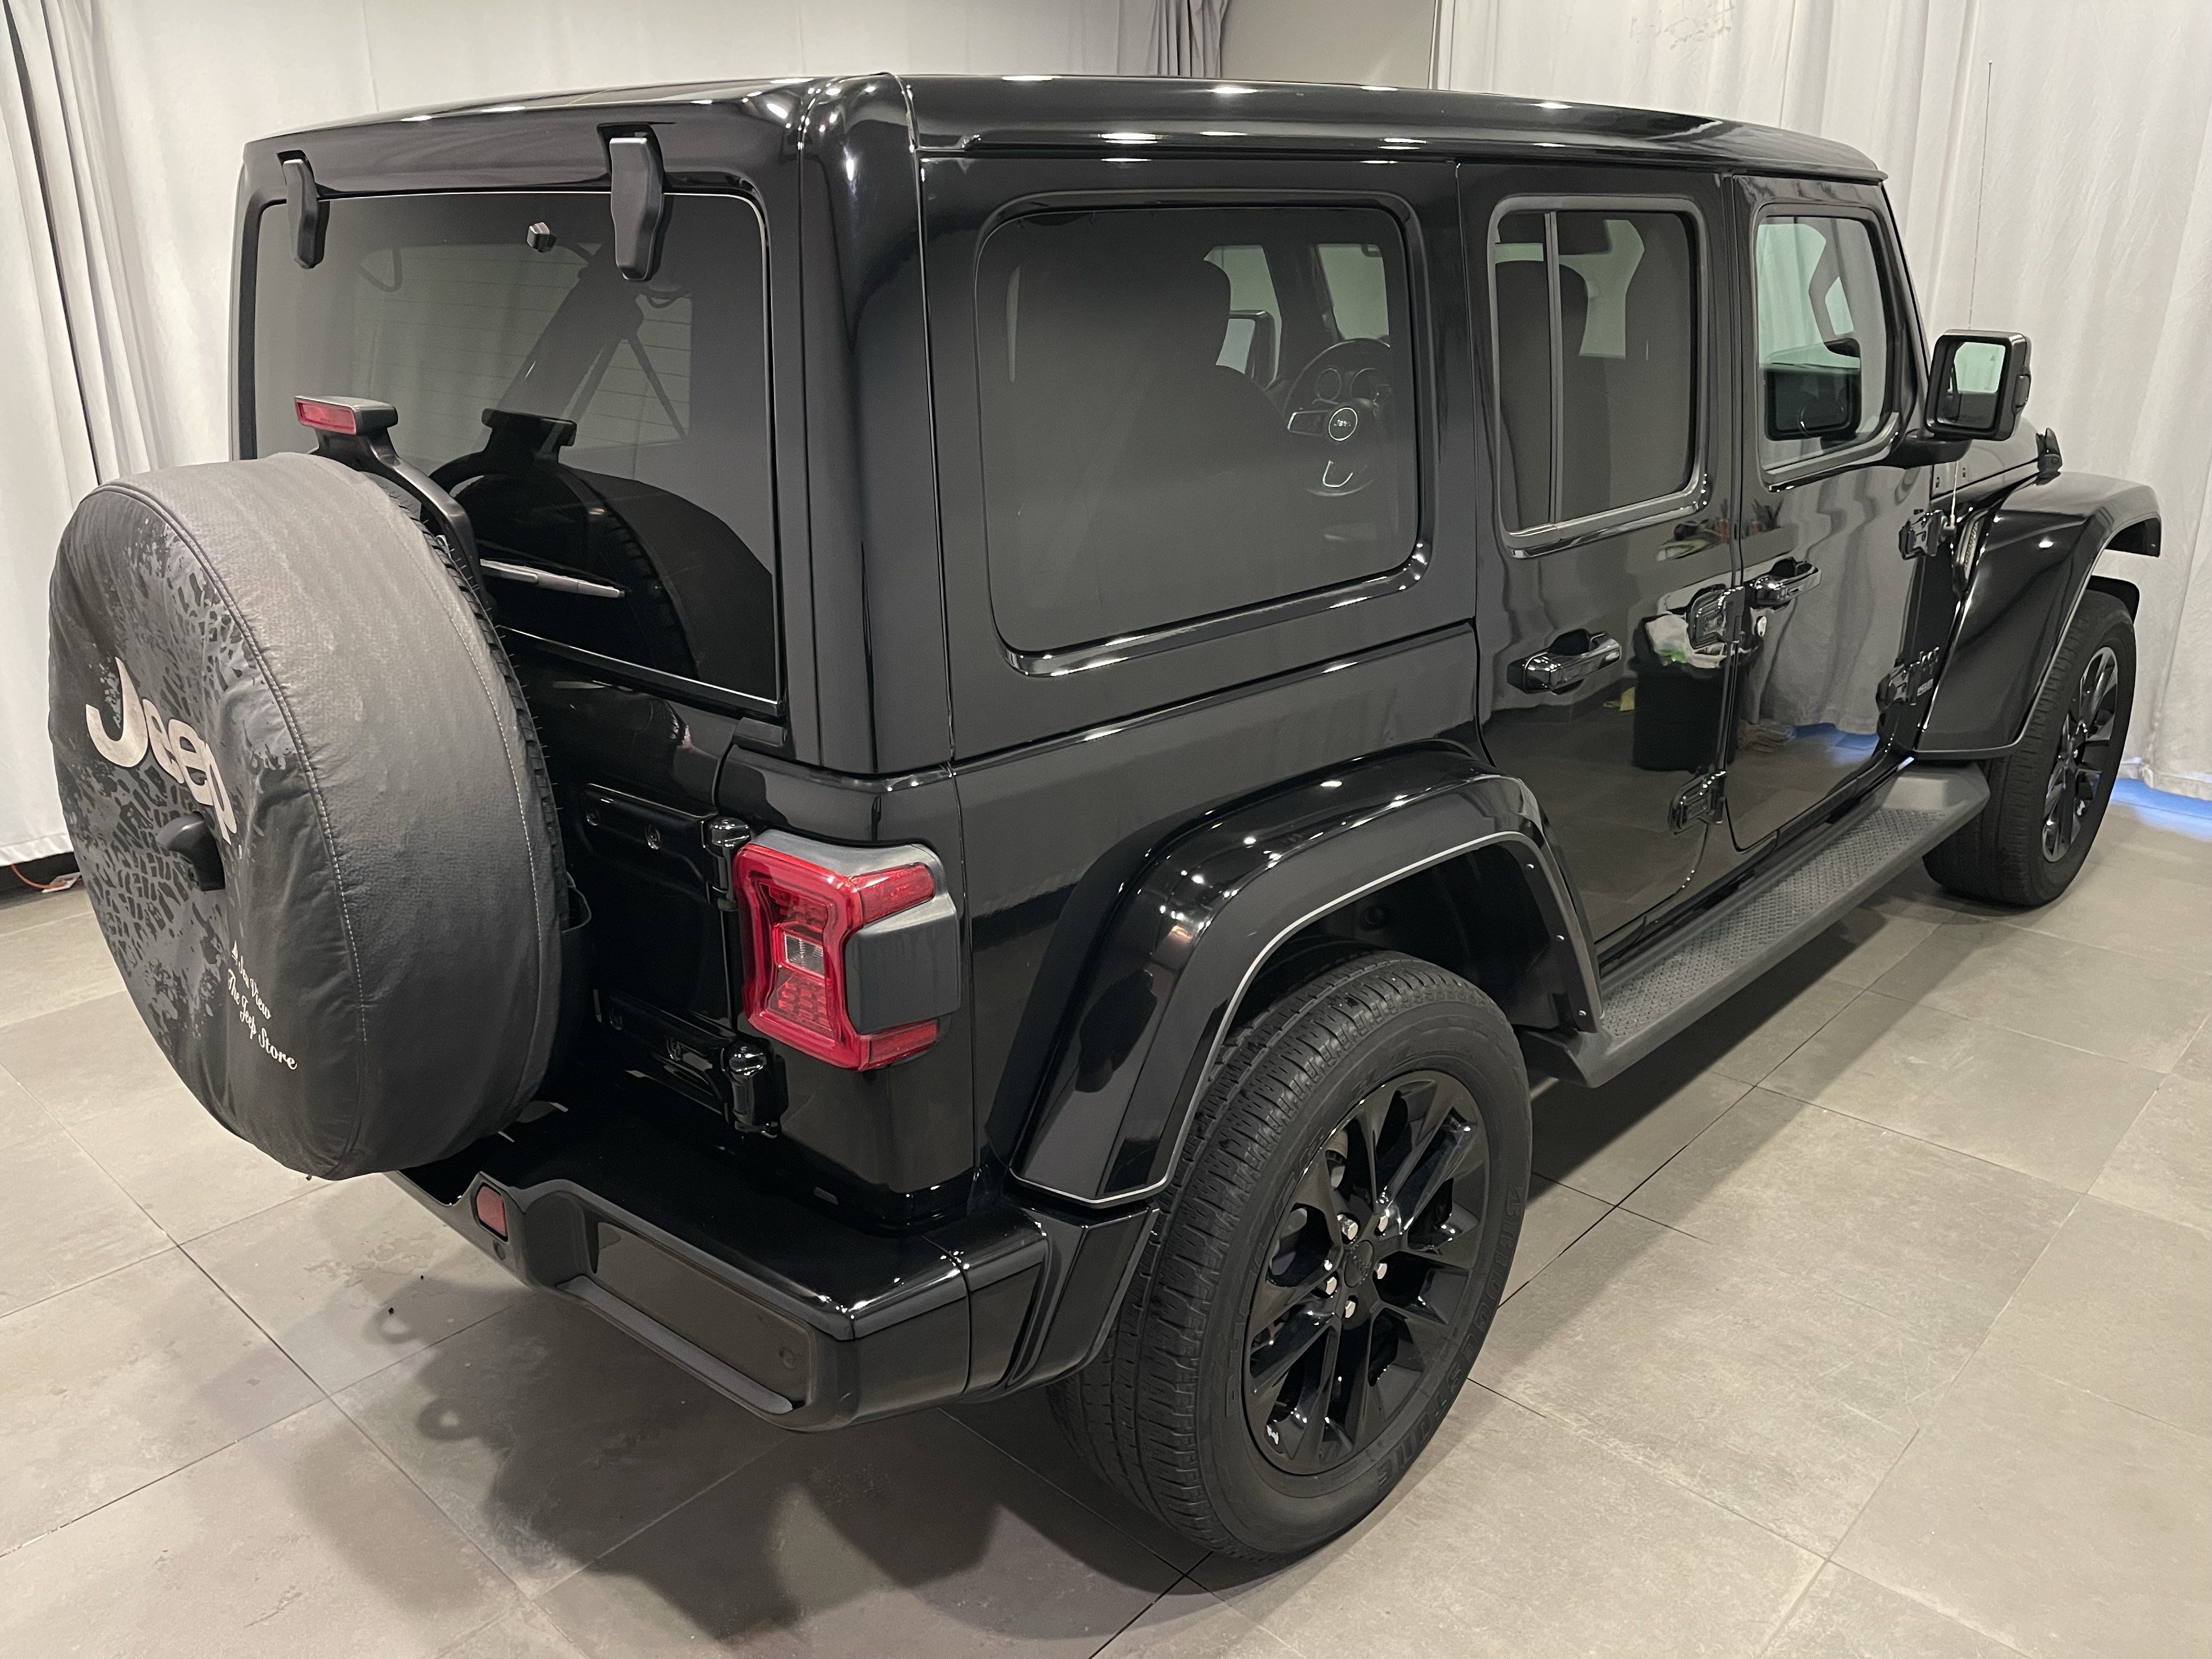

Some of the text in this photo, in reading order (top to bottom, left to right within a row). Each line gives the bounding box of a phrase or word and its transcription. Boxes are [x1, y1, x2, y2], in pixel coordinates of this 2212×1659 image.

[86, 657, 237, 845] Jeep
[228, 968, 297, 1070] The Jeep Store
[250, 978, 272, 1019] View
[1376, 1185, 1525, 1491] BRIDGESTONE
